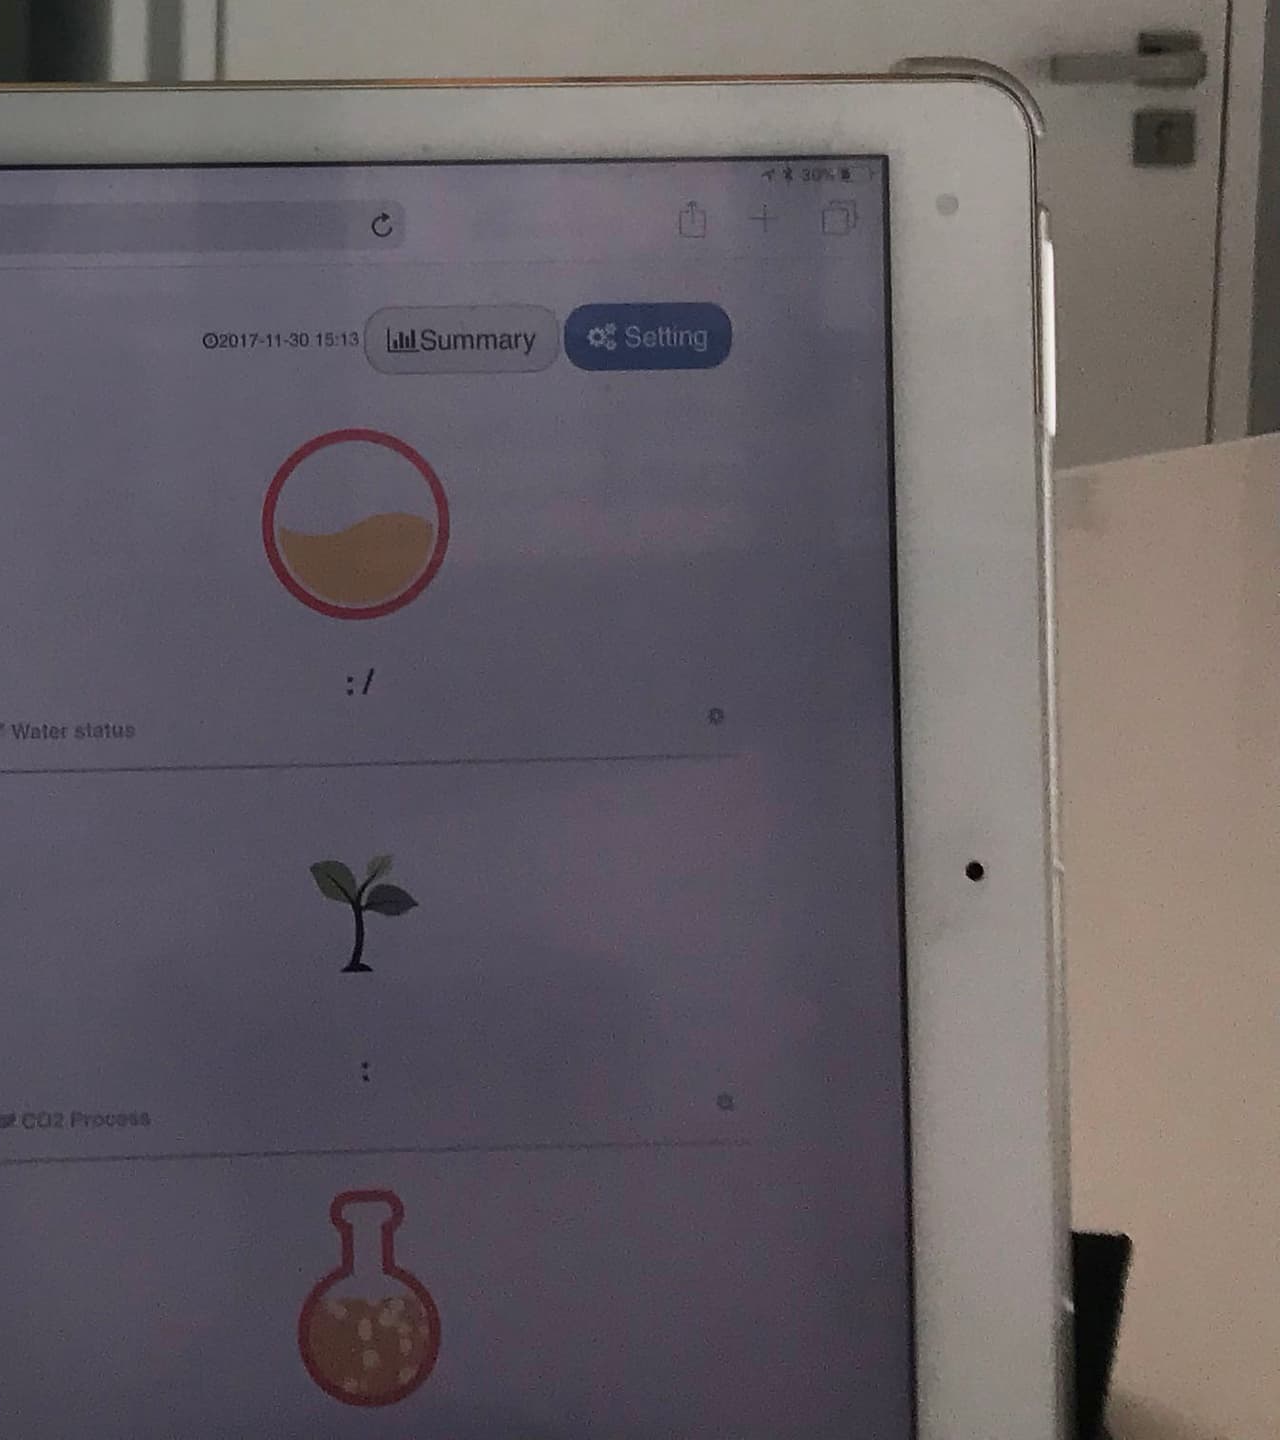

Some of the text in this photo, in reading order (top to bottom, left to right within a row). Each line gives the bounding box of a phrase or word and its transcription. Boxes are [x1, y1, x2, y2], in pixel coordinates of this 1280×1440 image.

[218, 331, 360, 349] 2017-11-30 15:13
[420, 327, 536, 355] Summary
[624, 323, 709, 351] Setting
[11, 722, 136, 740] Water status
[70, 1110, 151, 1128] Process
